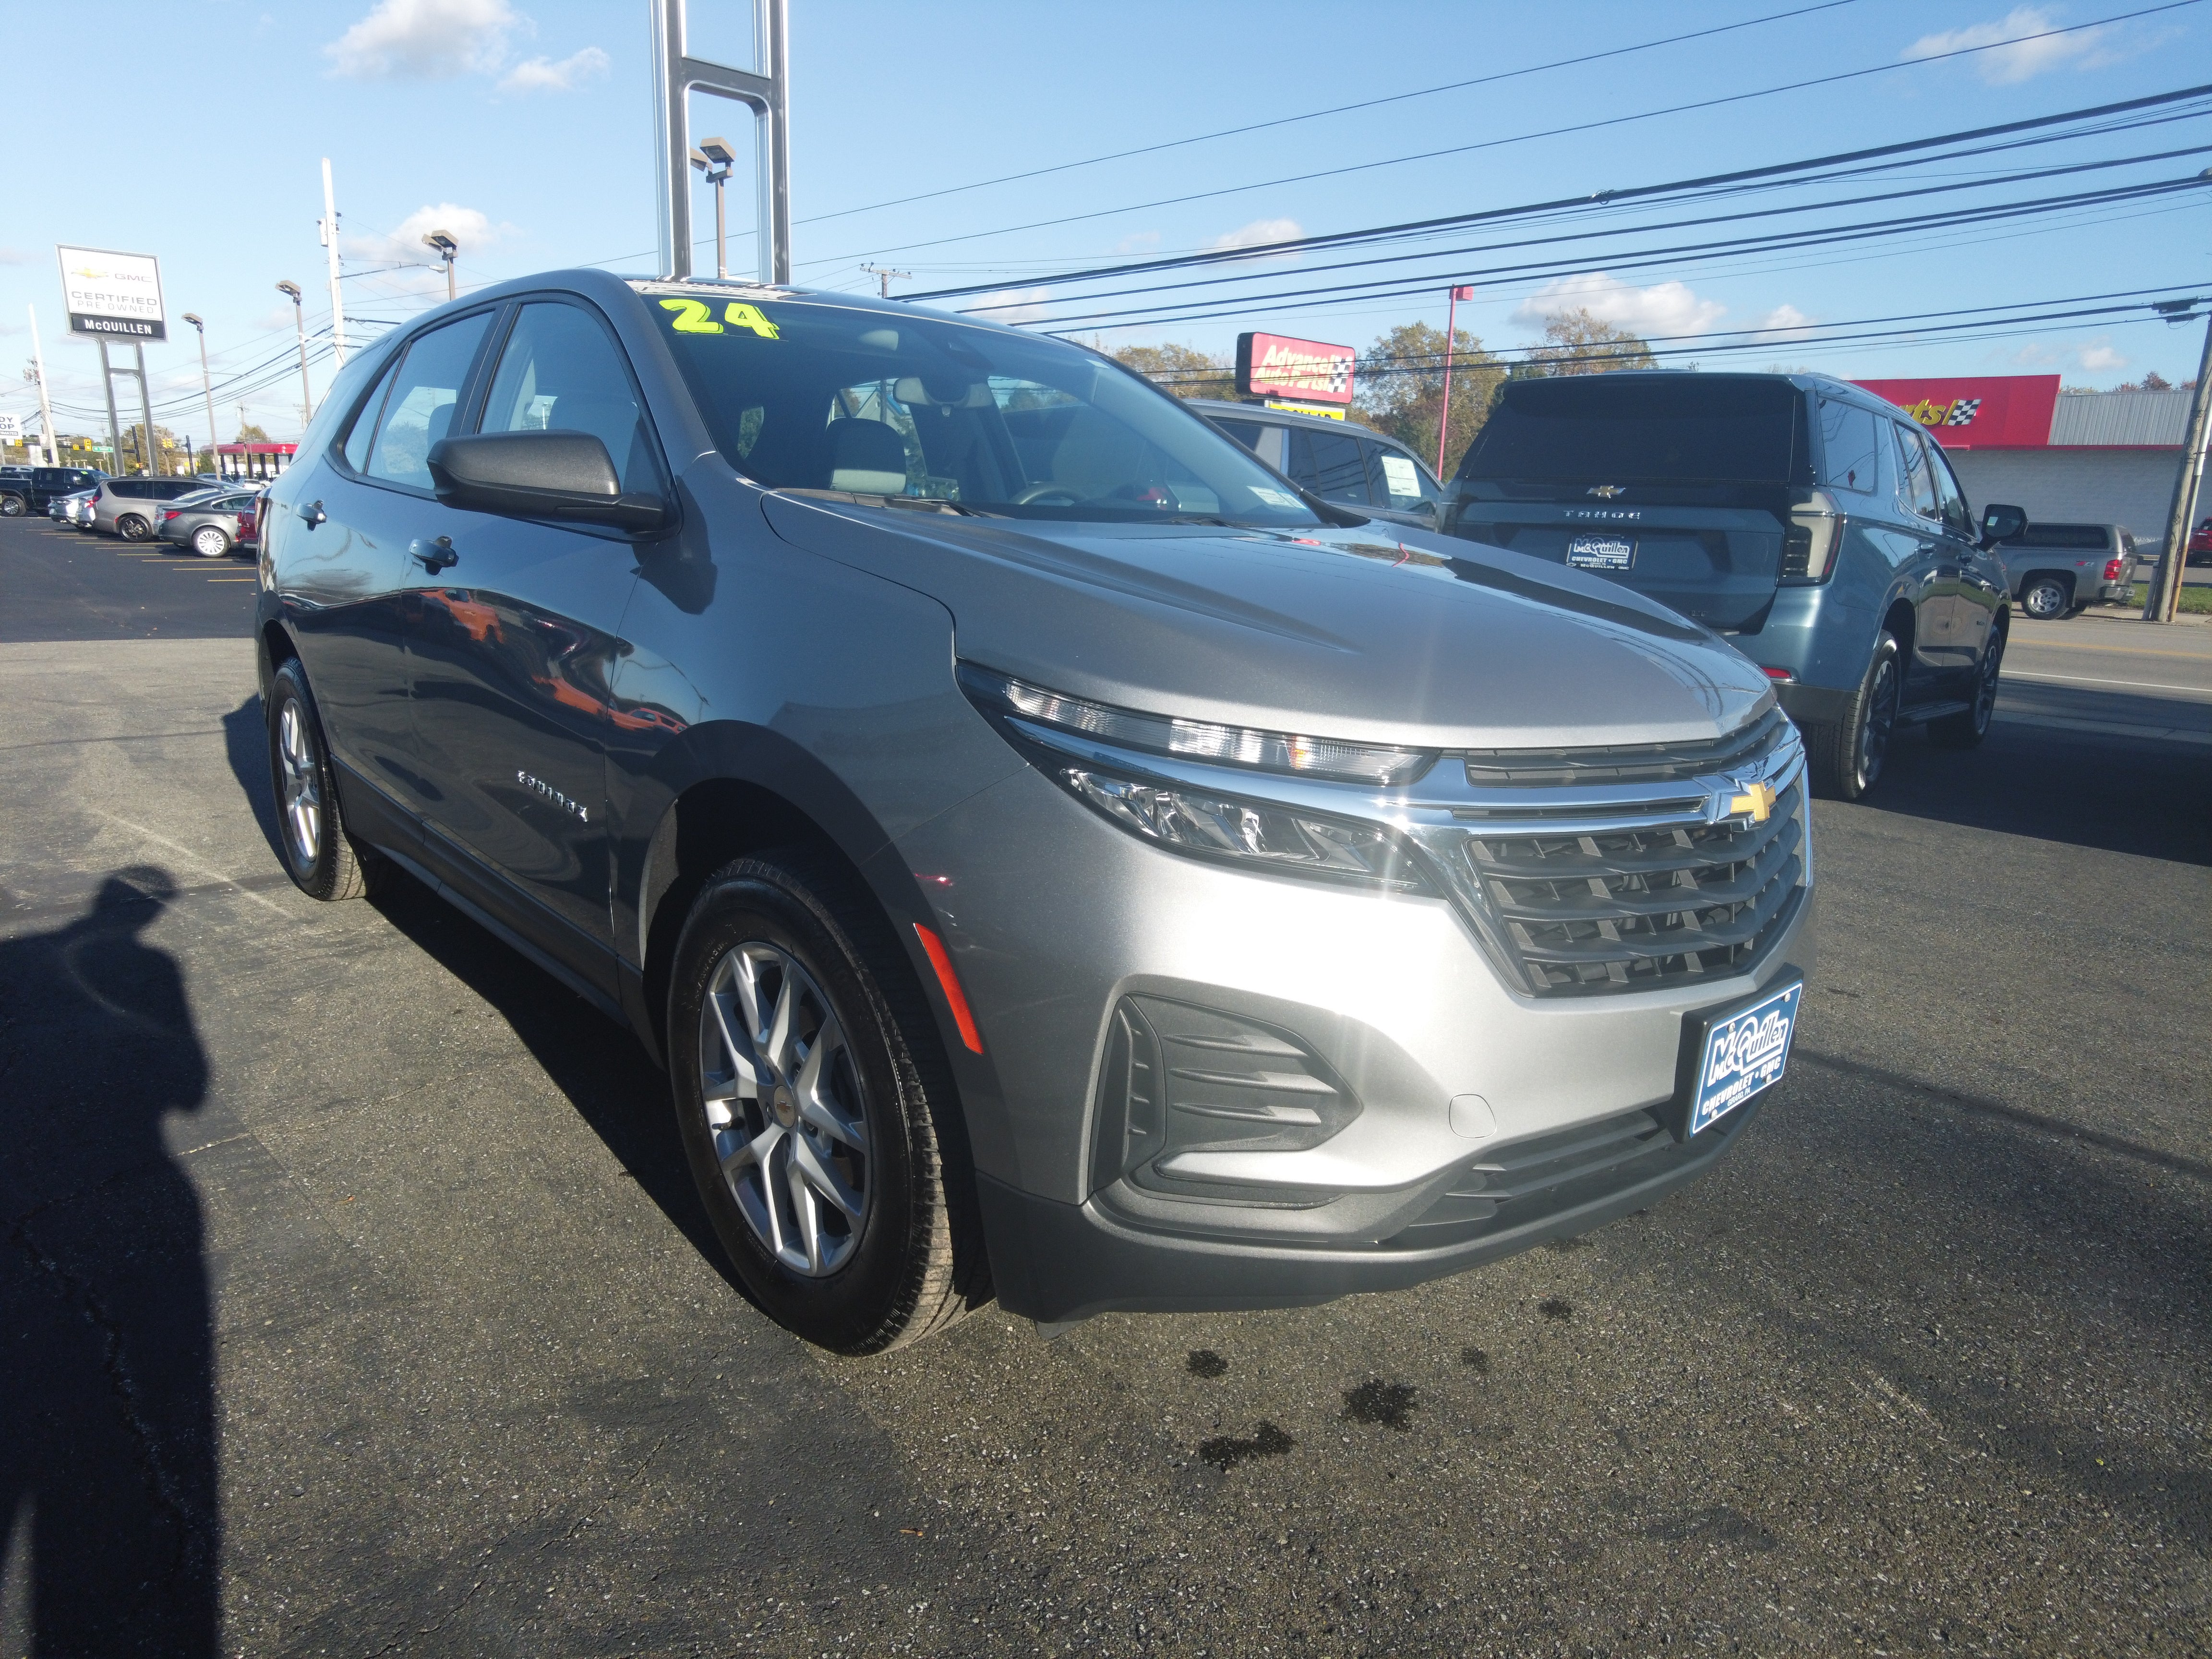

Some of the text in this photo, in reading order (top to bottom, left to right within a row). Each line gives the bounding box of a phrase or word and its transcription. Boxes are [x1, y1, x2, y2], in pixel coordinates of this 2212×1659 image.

[115, 273, 153, 283] GMC
[72, 291, 157, 306] CERTIFIED
[84, 319, 152, 335] McQUILLEN
[659, 299, 780, 339] 24
[1262, 345, 1329, 374] Advance
[1563, 510, 1641, 519] TAHOE
[517, 770, 588, 822] EQUINOX
[1702, 1056, 1781, 1116] CHEVROLET GMC
[1744, 1087, 1751, 1096] PA
